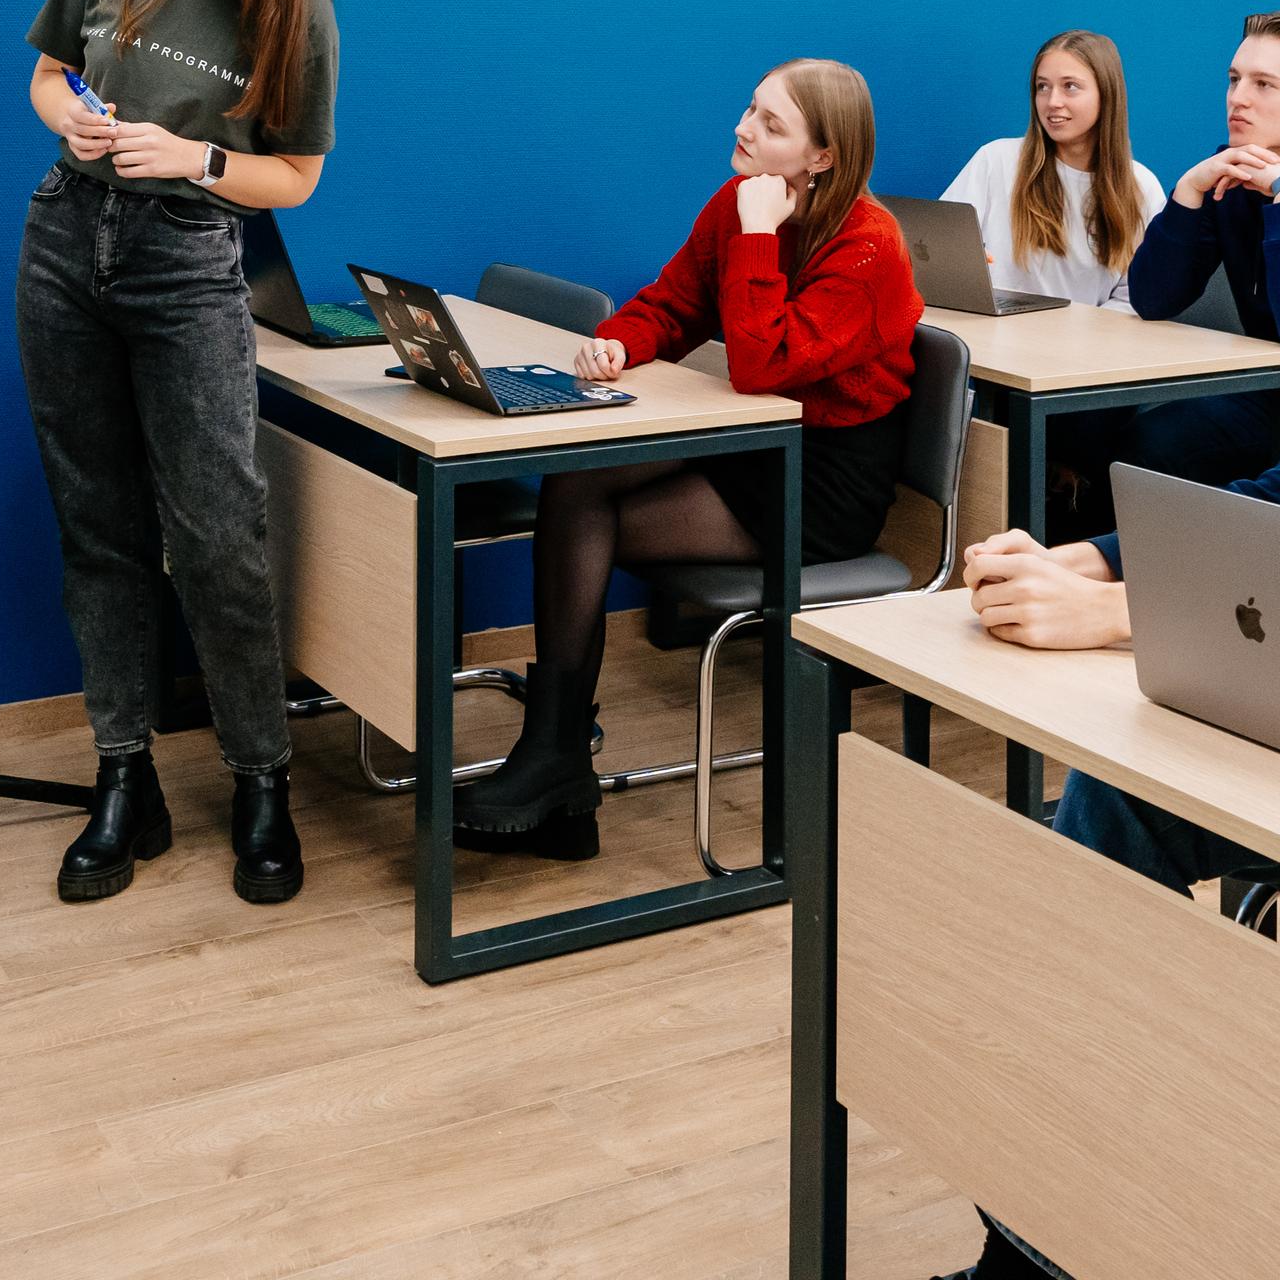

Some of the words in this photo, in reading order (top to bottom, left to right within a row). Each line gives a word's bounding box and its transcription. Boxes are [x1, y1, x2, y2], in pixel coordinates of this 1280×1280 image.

[86, 27, 108, 39] SHE
[132, 37, 142, 49] A
[149, 41, 254, 92] PROGRAMME
